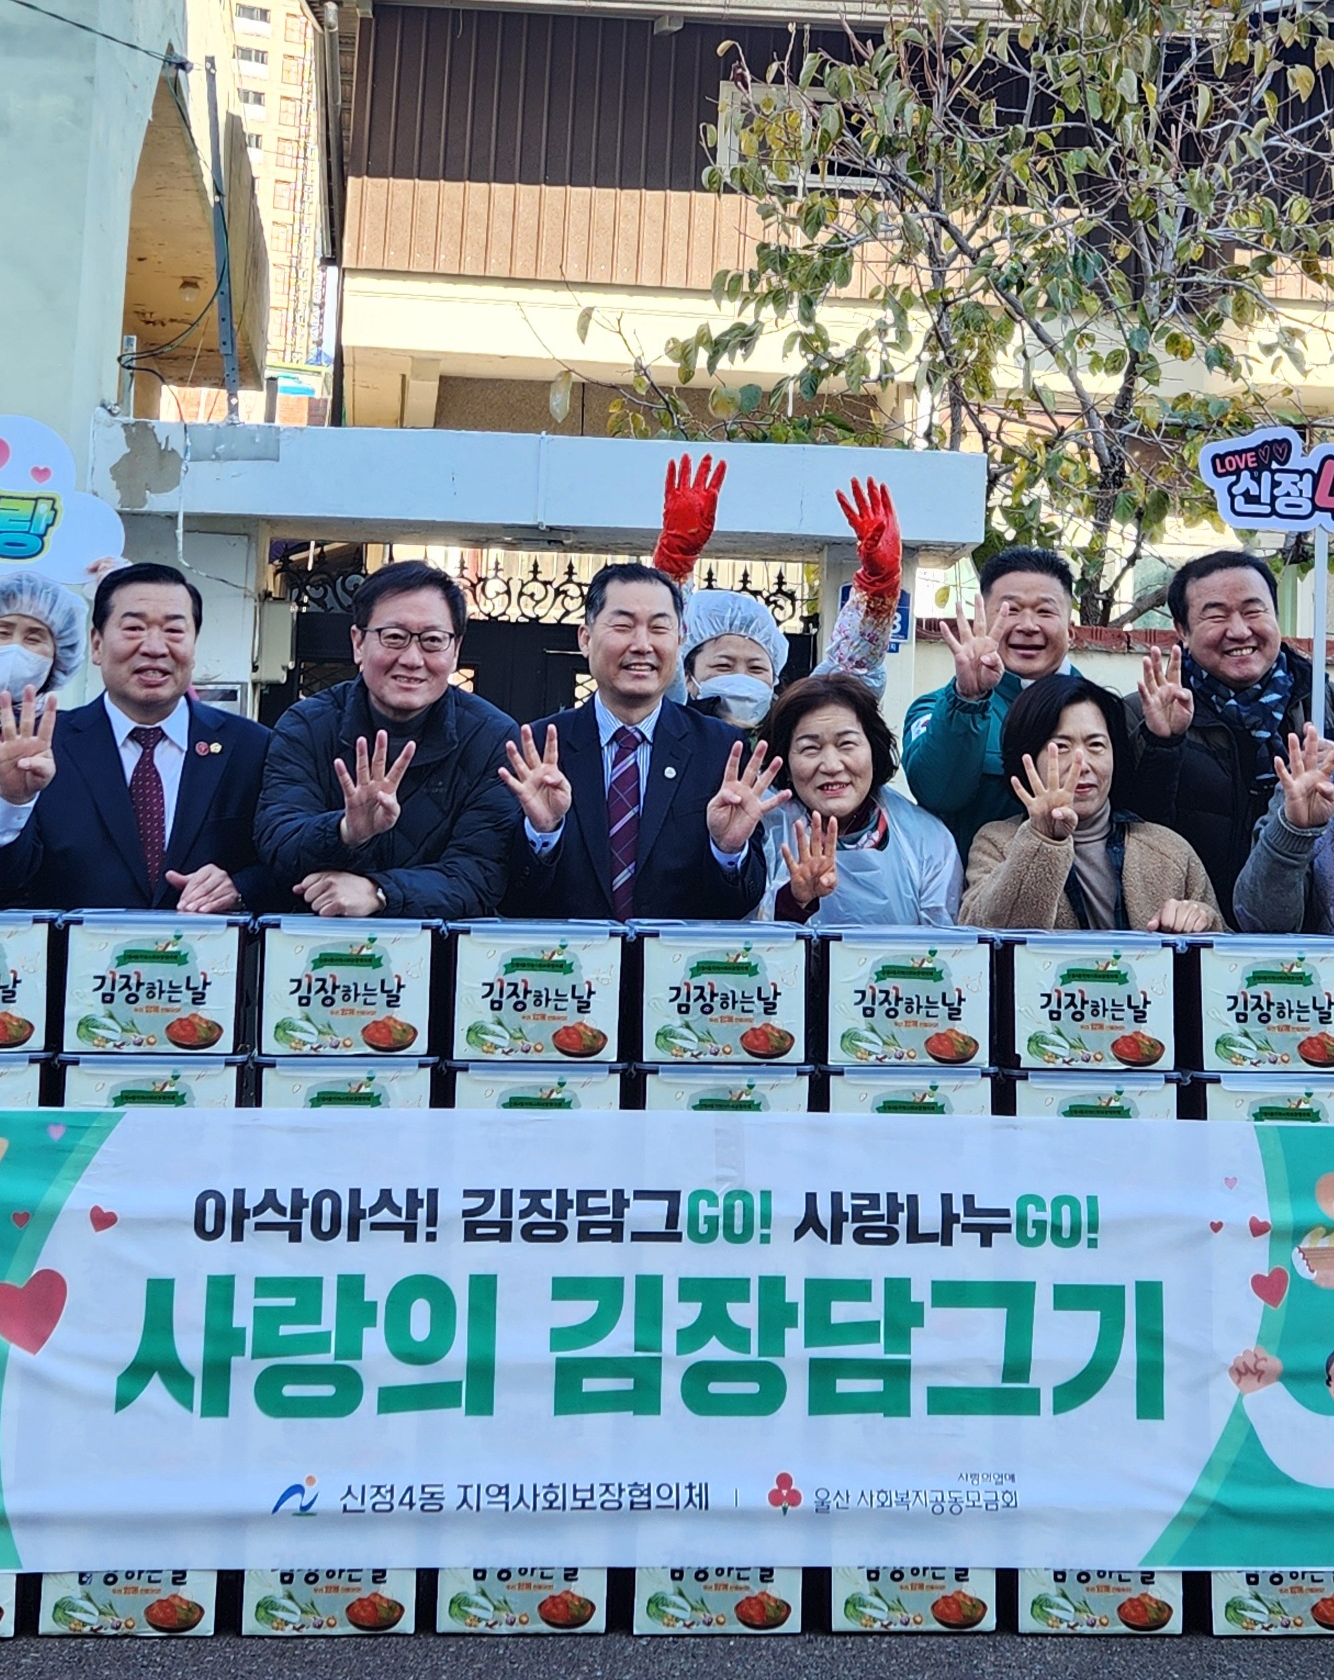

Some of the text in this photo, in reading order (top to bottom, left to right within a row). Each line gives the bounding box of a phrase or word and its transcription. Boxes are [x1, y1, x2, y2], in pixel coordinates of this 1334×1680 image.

[1214, 451, 1259, 475] LOVE
[93, 971, 211, 1005] 김장하는날
[289, 974, 406, 1008] 김장하는날
[481, 978, 596, 1013] 김장하는날
[669, 982, 782, 1015] 김장하는날
[854, 987, 966, 1021] 김장하는날
[1040, 990, 1151, 1023] 김장하는날
[194, 1187, 1100, 1250] 아삭아삭! 김장담그GO! 사랑나누GO!
[114, 1273, 1165, 1421] 사랑의 김장담그기
[339, 1481, 710, 1514] 신정4동 지역사회보장협의체
[814, 1487, 1019, 1516] 울산 사회복지공동모금회
